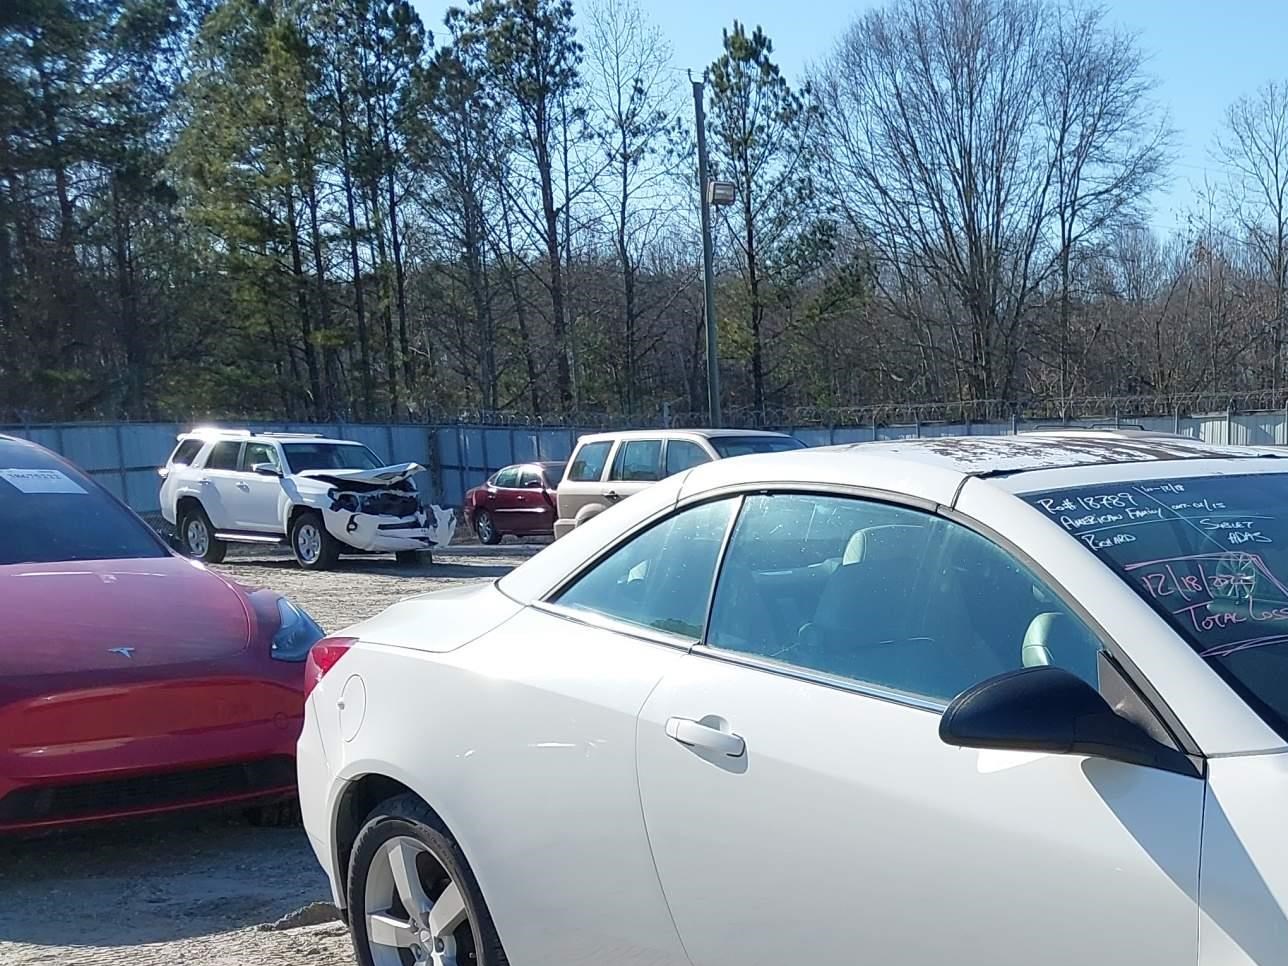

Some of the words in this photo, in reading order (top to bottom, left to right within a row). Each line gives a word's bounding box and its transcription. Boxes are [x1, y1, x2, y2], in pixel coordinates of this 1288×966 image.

[1077, 492, 1138, 511] 18789
[1060, 513, 1123, 531] AMERICAN
[1227, 531, 1273, 545] ADAS
[1172, 600, 1246, 633] TOTAL
